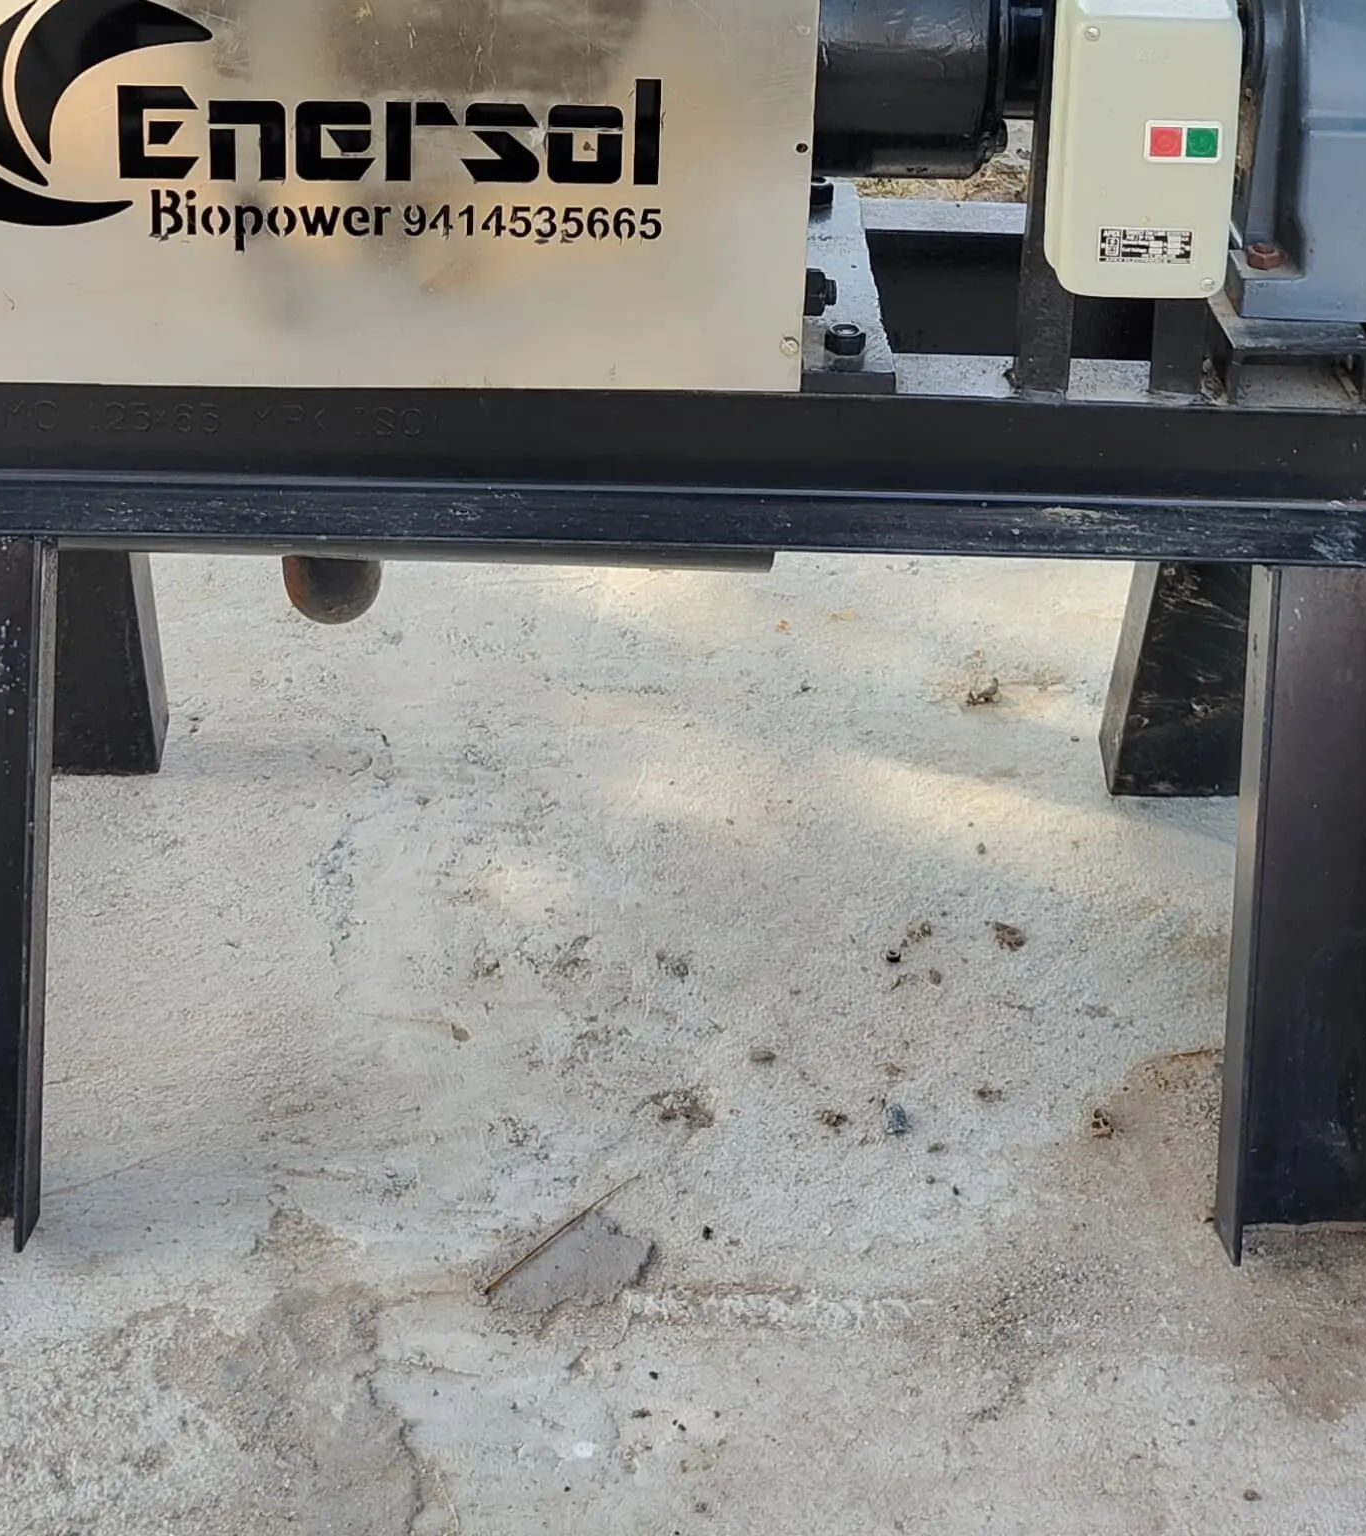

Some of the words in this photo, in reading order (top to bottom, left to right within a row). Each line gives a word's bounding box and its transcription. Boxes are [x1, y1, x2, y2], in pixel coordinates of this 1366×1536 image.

[116, 78, 662, 186] Enersol
[149, 188, 391, 252] Biopower
[402, 204, 662, 241] 9414535665
